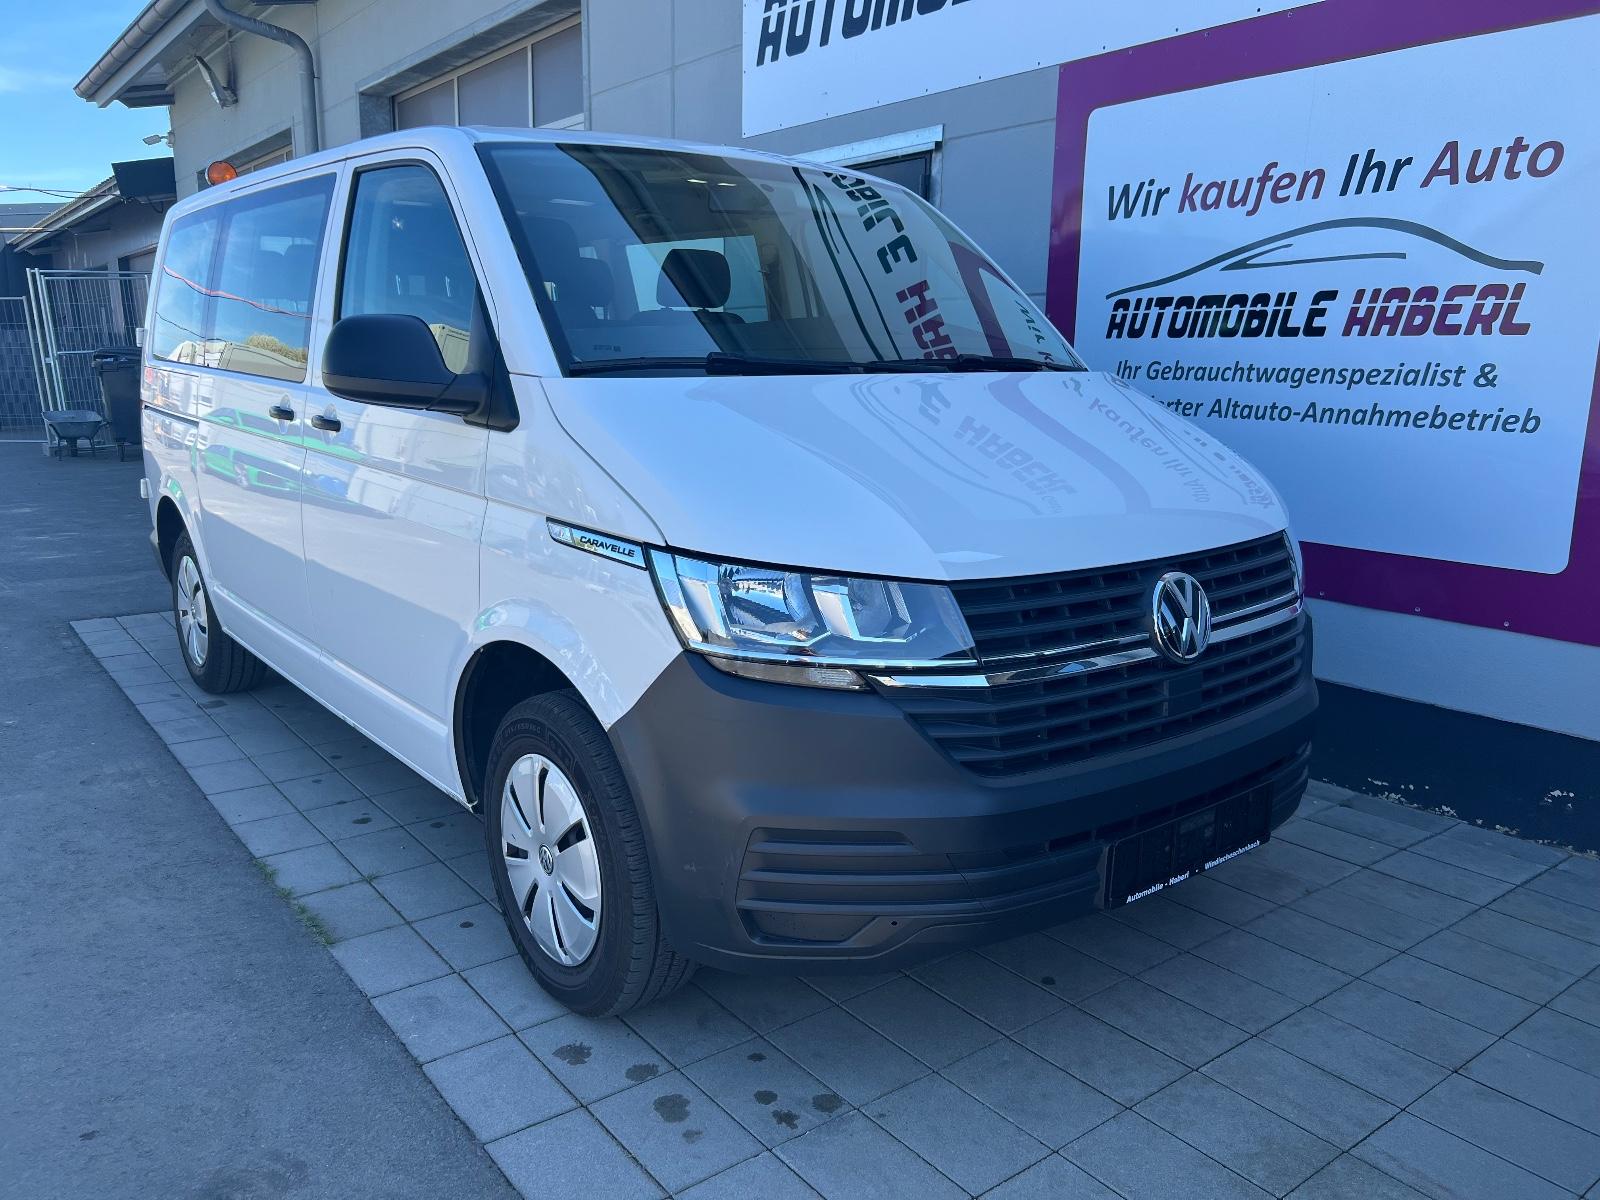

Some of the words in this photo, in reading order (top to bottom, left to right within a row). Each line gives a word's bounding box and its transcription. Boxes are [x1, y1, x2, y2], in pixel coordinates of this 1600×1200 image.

[1108, 178, 1171, 221] Wir
[1178, 162, 1326, 217] kaufen
[1339, 148, 1414, 197] Ihr
[1420, 136, 1565, 189] Auto
[1105, 290, 1339, 340] AUTOMOBILE
[1341, 283, 1532, 338] HABERL
[1116, 360, 1142, 382] Ihr
[1146, 360, 1467, 393] Gebrauchtwagenspezialist
[1473, 362, 1499, 389] &
[1207, 398, 1542, 435] Altauto-Annahmebetrieb
[579, 535, 636, 558] CARAVELLE
[1126, 882, 1164, 904] Automobile
[1168, 870, 1190, 886] Haberl
